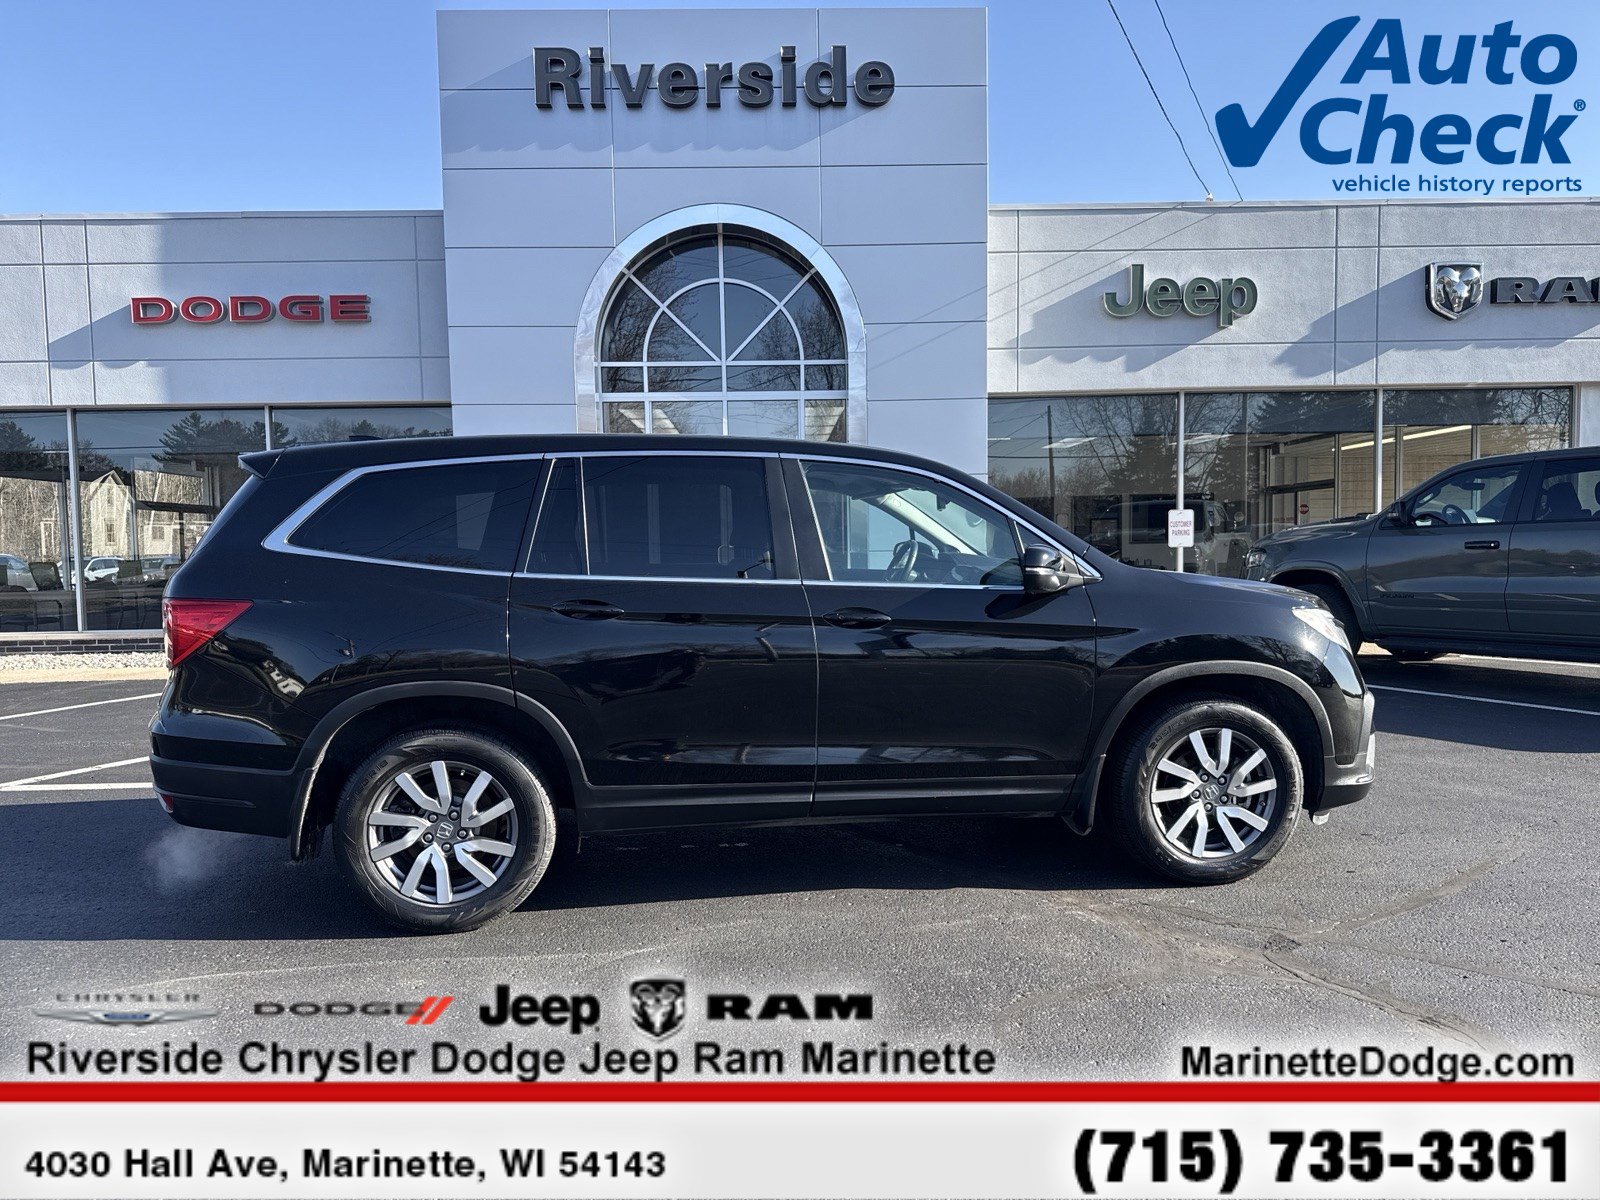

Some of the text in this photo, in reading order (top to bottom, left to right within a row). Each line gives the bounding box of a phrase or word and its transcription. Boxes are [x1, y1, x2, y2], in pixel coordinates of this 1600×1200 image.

[532, 45, 896, 109] Riverside
[1102, 263, 1258, 329] Jeep
[1490, 276, 1600, 304] RA
[130, 294, 372, 325] DODGE
[1169, 520, 1192, 528] CUSTOMER
